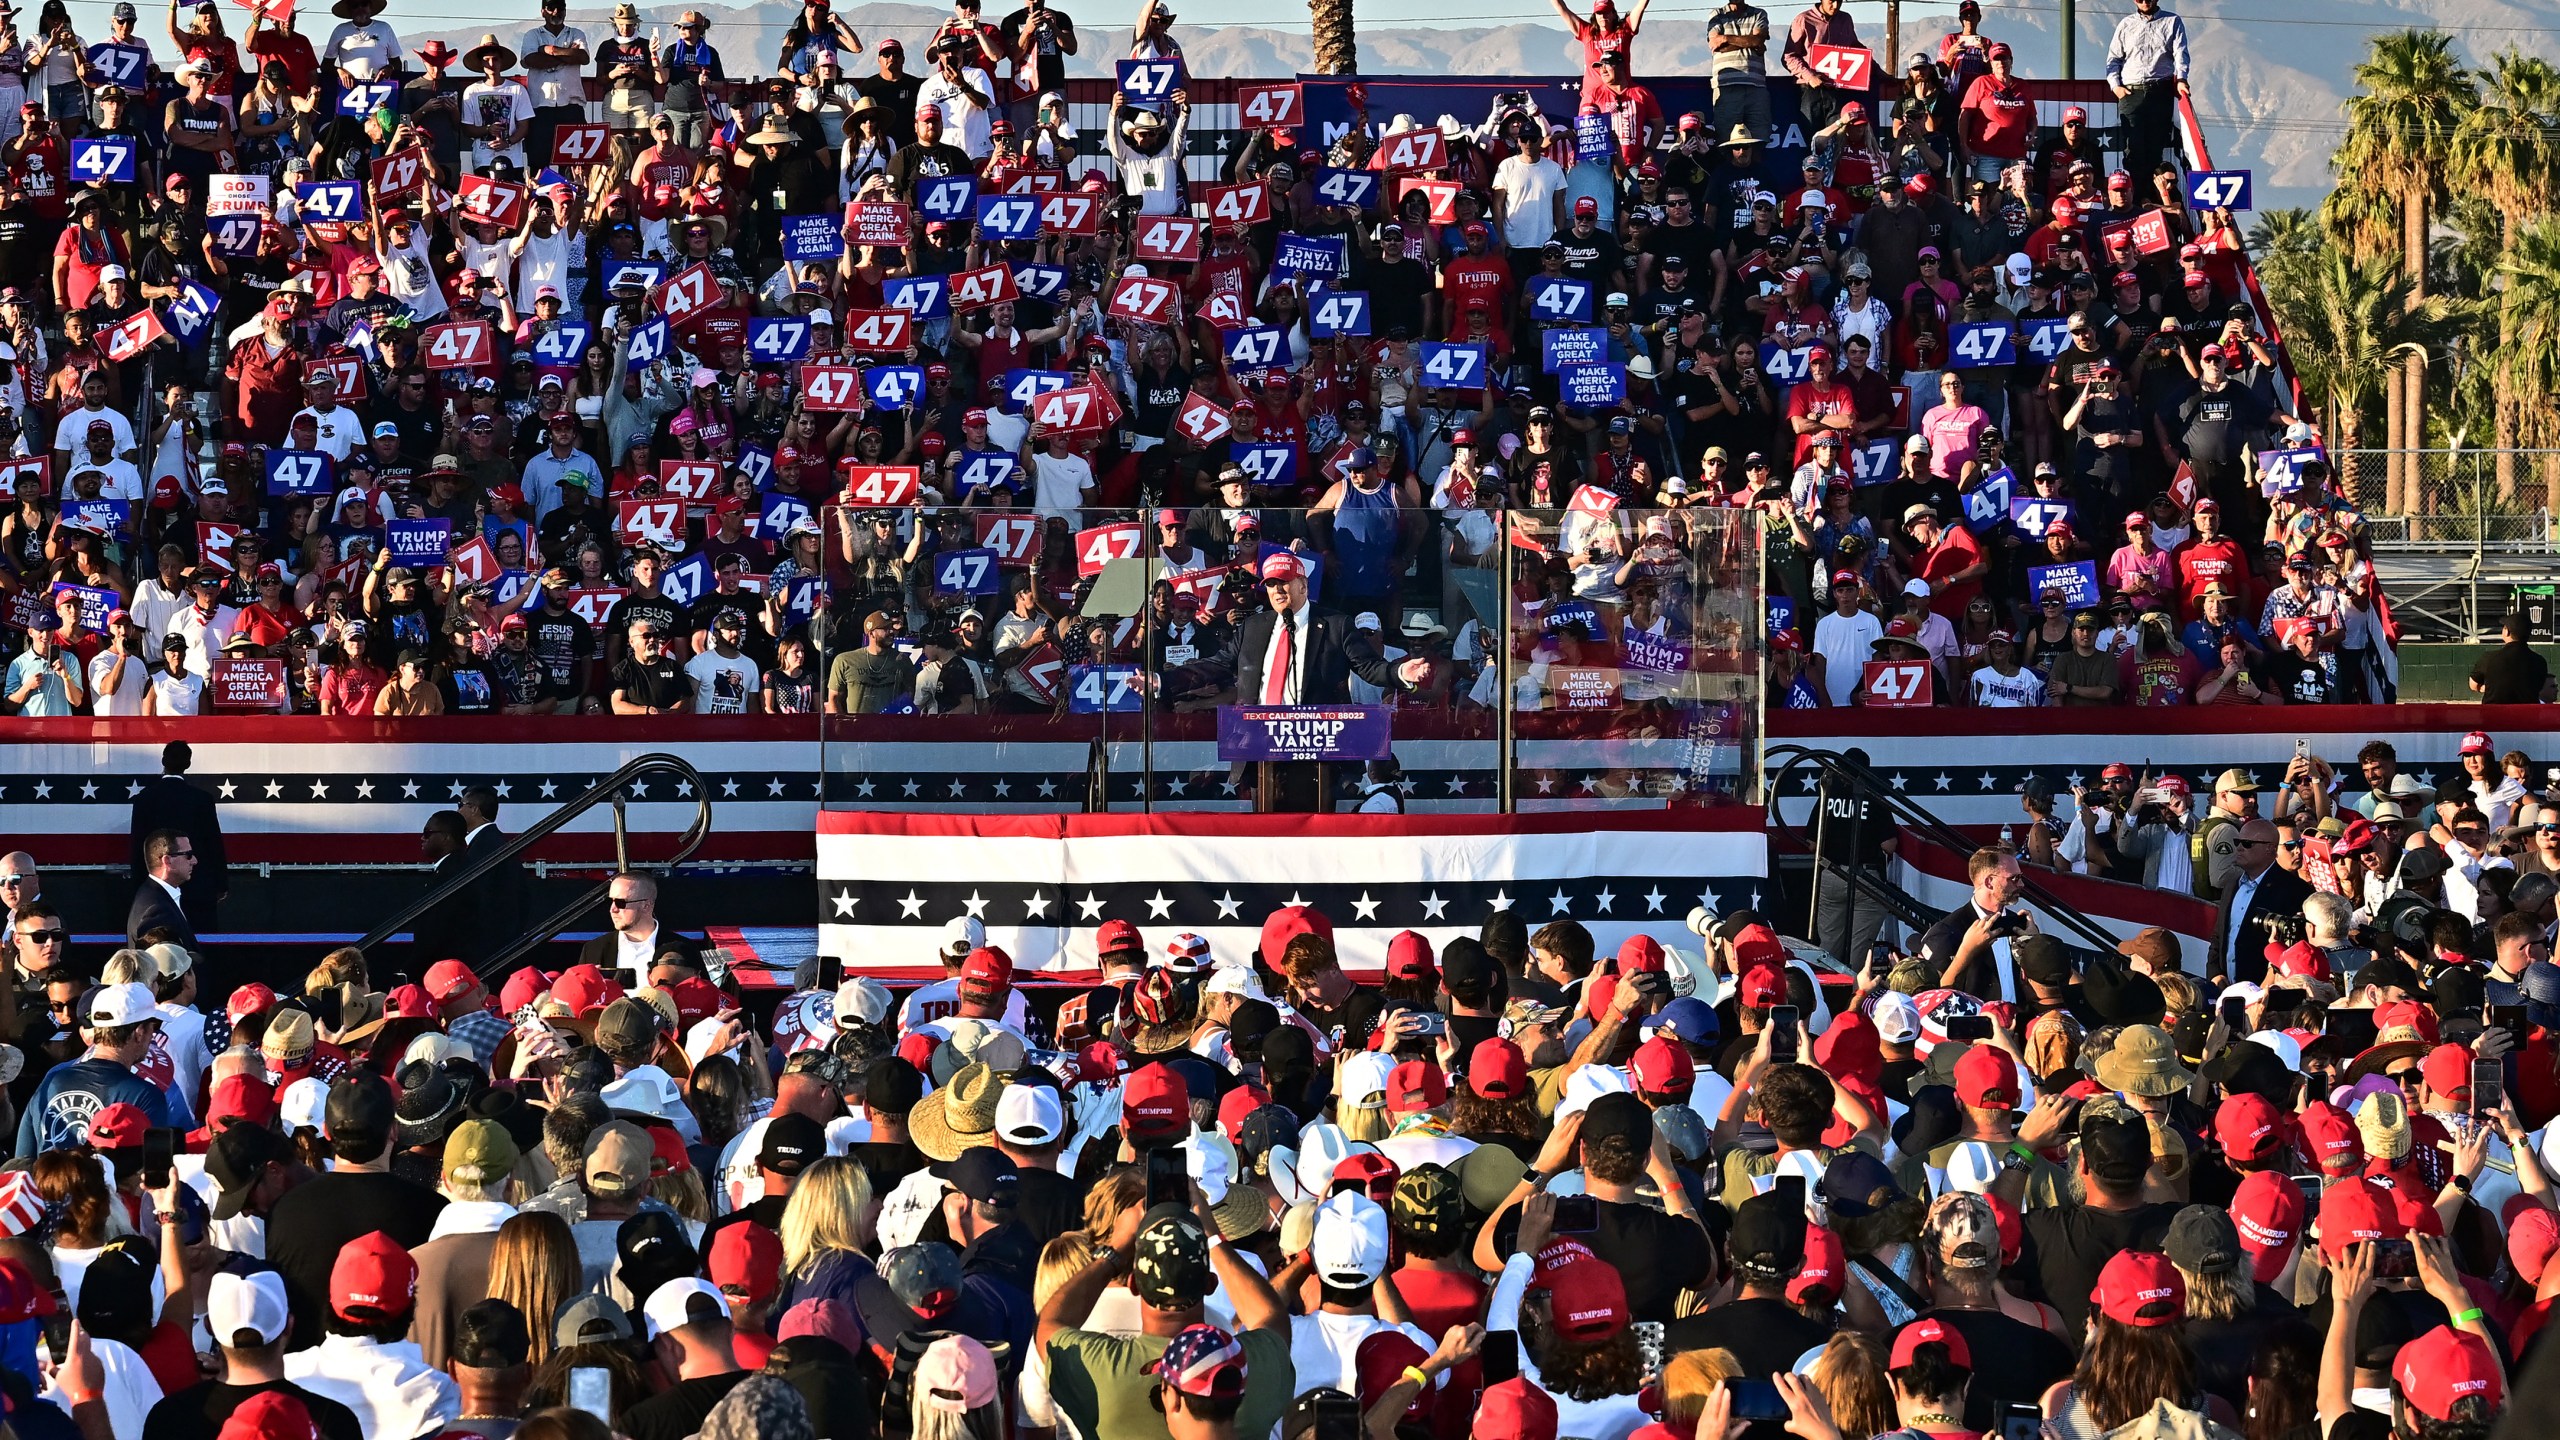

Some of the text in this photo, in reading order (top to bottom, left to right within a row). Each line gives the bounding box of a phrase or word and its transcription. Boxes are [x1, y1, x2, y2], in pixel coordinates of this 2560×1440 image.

[92, 47, 140, 78] 47
[1814, 51, 1865, 82] 47
[1124, 64, 1176, 95] 47
[1245, 90, 1296, 121] 47
[1992, 99, 2026, 107] VANCE
[2064, 108, 2085, 118] MAGA
[183, 118, 218, 130] TRUMP
[1577, 125, 1609, 136] AMERICA
[1578, 118, 1603, 129] MAKE
[558, 129, 605, 159] 47
[1579, 134, 1606, 144] GREAT
[1391, 134, 1437, 167] 47
[1579, 142, 1608, 152] AGAIN!
[76, 145, 128, 175] 47
[379, 155, 418, 192] 47
[223, 182, 256, 192] GOD
[1319, 174, 1372, 203] 47
[2194, 176, 2244, 206] 47
[305, 186, 355, 217] 47
[464, 184, 517, 218] 47
[924, 181, 971, 215] 47
[1214, 185, 1262, 218] 47
[862, 205, 894, 216] MAKE
[983, 201, 1035, 233] 47
[1041, 197, 1091, 230] 47
[798, 218, 828, 229] MAKE
[853, 213, 902, 224] AMERICA
[790, 226, 838, 238] AMERICA
[860, 222, 895, 232] GREAT
[218, 221, 260, 249] 47
[796, 235, 830, 246] GREAT
[858, 231, 896, 241] AGAIN!
[1142, 222, 1192, 253] 47
[796, 243, 834, 254] AGAIN!
[1563, 246, 1599, 260] Trump
[1278, 254, 1334, 271] TRUMP
[248, 278, 282, 289] BRANDON
[301, 271, 331, 295] 47
[960, 269, 1004, 302] 47
[1014, 272, 1060, 296] 47
[1458, 272, 1500, 286] Trump
[664, 270, 706, 314] 47
[890, 282, 940, 314] 47
[1117, 283, 1170, 313] 47
[1537, 284, 1585, 314] 47
[178, 285, 209, 337] 47
[1210, 294, 1242, 319] 47
[1316, 297, 1362, 328] 47
[707, 321, 741, 329] AMERICA
[855, 316, 906, 345] 47
[106, 316, 148, 356] 47
[427, 326, 484, 359] 47
[536, 327, 586, 358] 47
[628, 324, 665, 360] 47
[754, 324, 804, 354] 47
[1557, 332, 1590, 342] MAKE
[1232, 331, 1280, 364] 47
[1550, 341, 1599, 351] AMERICA
[1956, 329, 2006, 360] 47
[1556, 349, 1593, 359] GREAT
[1425, 350, 1478, 380] 47
[1576, 367, 1608, 377] MAKE
[808, 372, 855, 403] 47
[1568, 376, 1617, 385] AMERICA
[1149, 389, 1181, 399] ULTRA
[1574, 384, 1611, 394] GREAT
[1149, 395, 1181, 404] MAGA
[1574, 393, 1612, 403] AGAIN!
[1045, 394, 1091, 428] 47
[2203, 402, 2229, 412] TRUMP
[1182, 404, 1231, 440] 47
[272, 457, 322, 487] 47
[738, 452, 772, 484] 47
[961, 458, 1014, 483] 47
[1240, 450, 1289, 480] 47
[664, 468, 716, 498] 47
[856, 472, 911, 504] 47
[1970, 476, 2010, 521] 47
[79, 503, 111, 513] MAKE
[627, 505, 678, 533] 47
[766, 500, 809, 533] 47
[2017, 504, 2068, 536] 47
[391, 530, 446, 545] TRUMP
[982, 520, 1035, 558] 47
[397, 542, 443, 552] VANCE
[1771, 541, 1790, 550] 1776
[940, 556, 990, 589] 47
[2045, 568, 2078, 578] MAKE
[2191, 561, 2227, 570] TRUMP
[662, 560, 703, 599] 47
[2038, 575, 2089, 588] AMERICA
[623, 606, 673, 622] JESUS
[539, 624, 574, 634] JESUS
[1626, 639, 1684, 665] TRUMP
[231, 664, 264, 672] MAKE
[1630, 652, 1675, 673] VANCE
[2136, 664, 2182, 674] MARIO
[221, 672, 274, 682] AMERICA
[1569, 672, 1601, 680] MAKE
[1870, 667, 1924, 700] 47
[228, 682, 266, 691] GREAT
[1075, 671, 1142, 704] 47
[1560, 681, 1612, 690] AMERICA
[1988, 683, 2026, 700] TRUMP
[227, 691, 268, 701] AGAIN!
[1569, 690, 1604, 698] GREAT
[1569, 699, 1608, 708] AGAIN!
[1265, 721, 1344, 735] TRUMP
[1274, 736, 1335, 747] VANCE
[2461, 735, 2484, 747] TRUMP
[1827, 798, 1869, 819] POLIE
[1753, 953, 1774, 962] TRUMP
[970, 969, 988, 977] TRUMP
[444, 975, 465, 987] TRUMP
[1754, 986, 1776, 996] TRUMP
[2249, 1125, 2272, 1139] TRUMP
[777, 1146, 803, 1154] TRUMP
[2325, 1140, 2352, 1149] TRUMP
[2240, 1213, 2288, 1239] MAKE AMERICA
[2352, 1230, 2382, 1239] TRUMP
[1538, 1245, 1566, 1261] MAKE
[1547, 1257, 1576, 1272] GREAT
[1802, 1269, 1829, 1279] TRUMP
[349, 1293, 379, 1303] TRUMP
[2137, 1288, 2172, 1300] TRUMP
[1569, 1309, 1612, 1322] TRUMP2020
[2452, 1379, 2487, 1392] TRUMP
